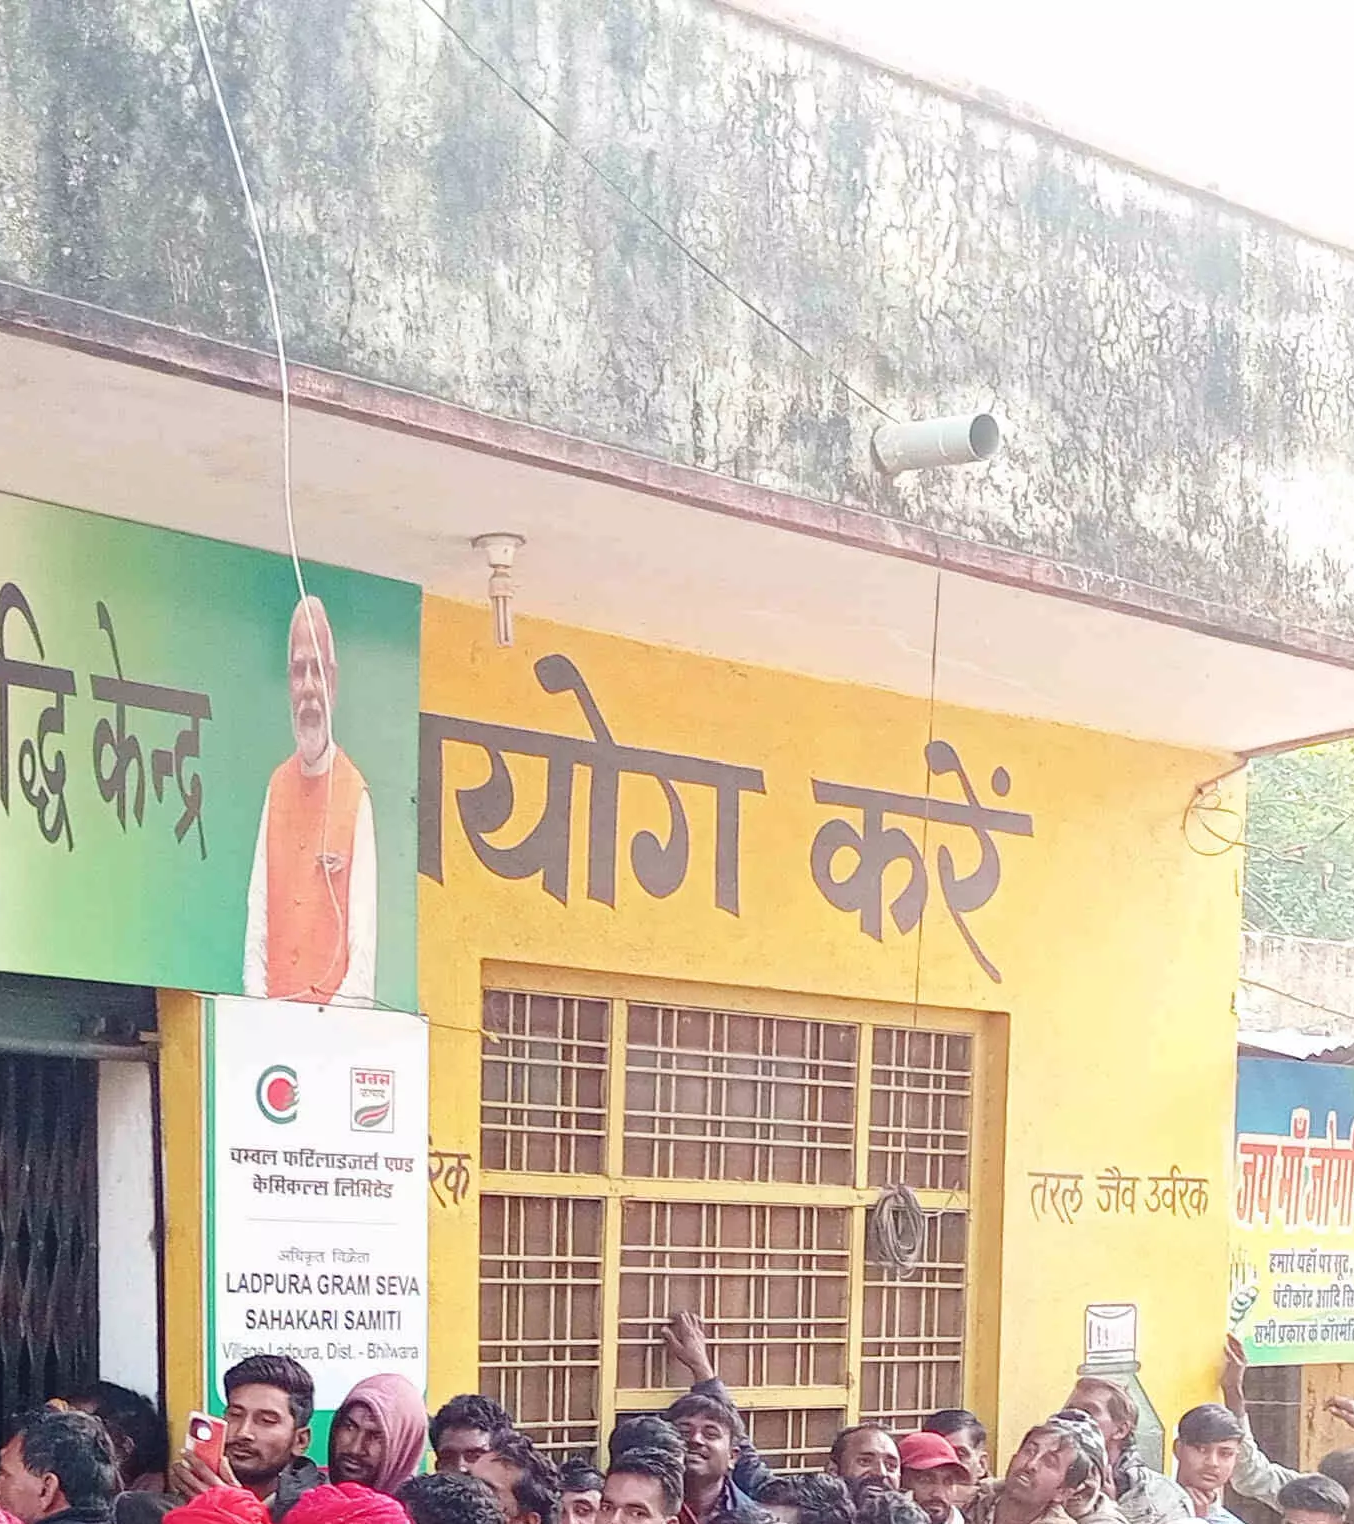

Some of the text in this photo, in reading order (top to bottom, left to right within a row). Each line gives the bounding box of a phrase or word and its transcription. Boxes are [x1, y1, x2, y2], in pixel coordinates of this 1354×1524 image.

[90, 600, 212, 860] केन्द्र
[810, 740, 1034, 984] करें
[334, 1177, 394, 1199] लिमिटेड
[1027, 1164, 1210, 1224] तरल जैव उर्वरक
[1237, 1143, 1278, 1225] जय
[226, 1272, 421, 1297] LADPURA GRAM SEVA
[245, 1309, 402, 1331] SAHAKARI SAMITI
[327, 1343, 356, 1361] Dist.
[367, 1343, 419, 1360] Bhilwara
